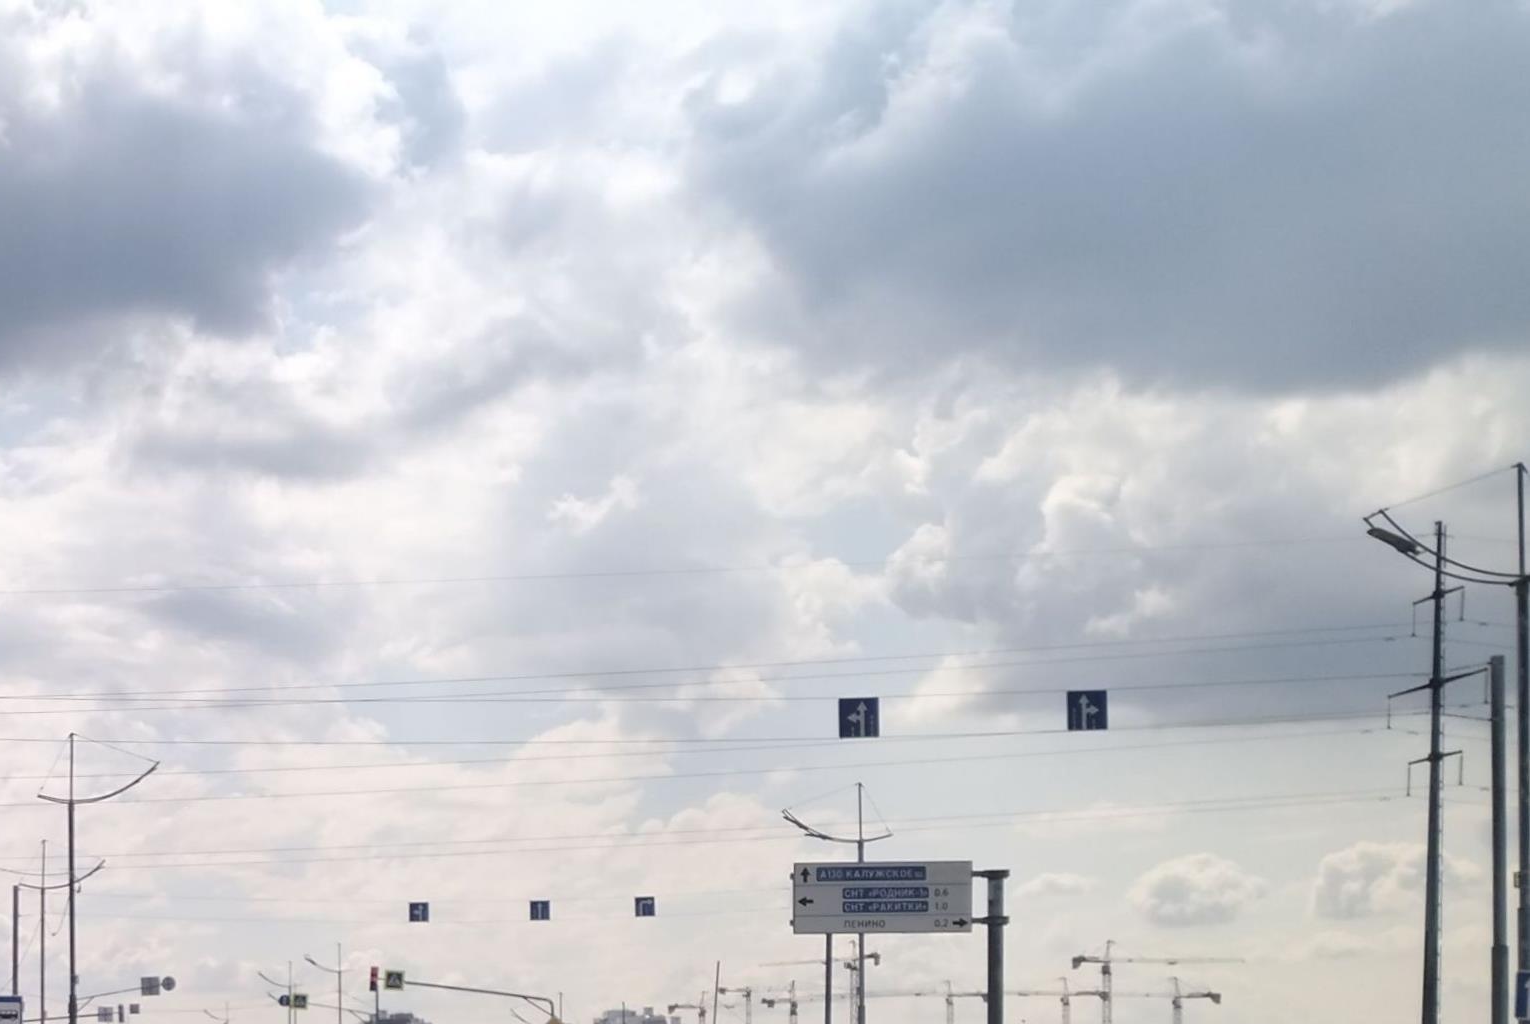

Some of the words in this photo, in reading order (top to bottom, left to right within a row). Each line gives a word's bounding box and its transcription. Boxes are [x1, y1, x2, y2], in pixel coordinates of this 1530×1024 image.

[845, 868, 912, 879] КАЛУЖСКОЕ
[844, 889, 864, 898] СНТ
[844, 903, 864, 912] СНТ
[843, 920, 886, 928] ЛЕНИНО
